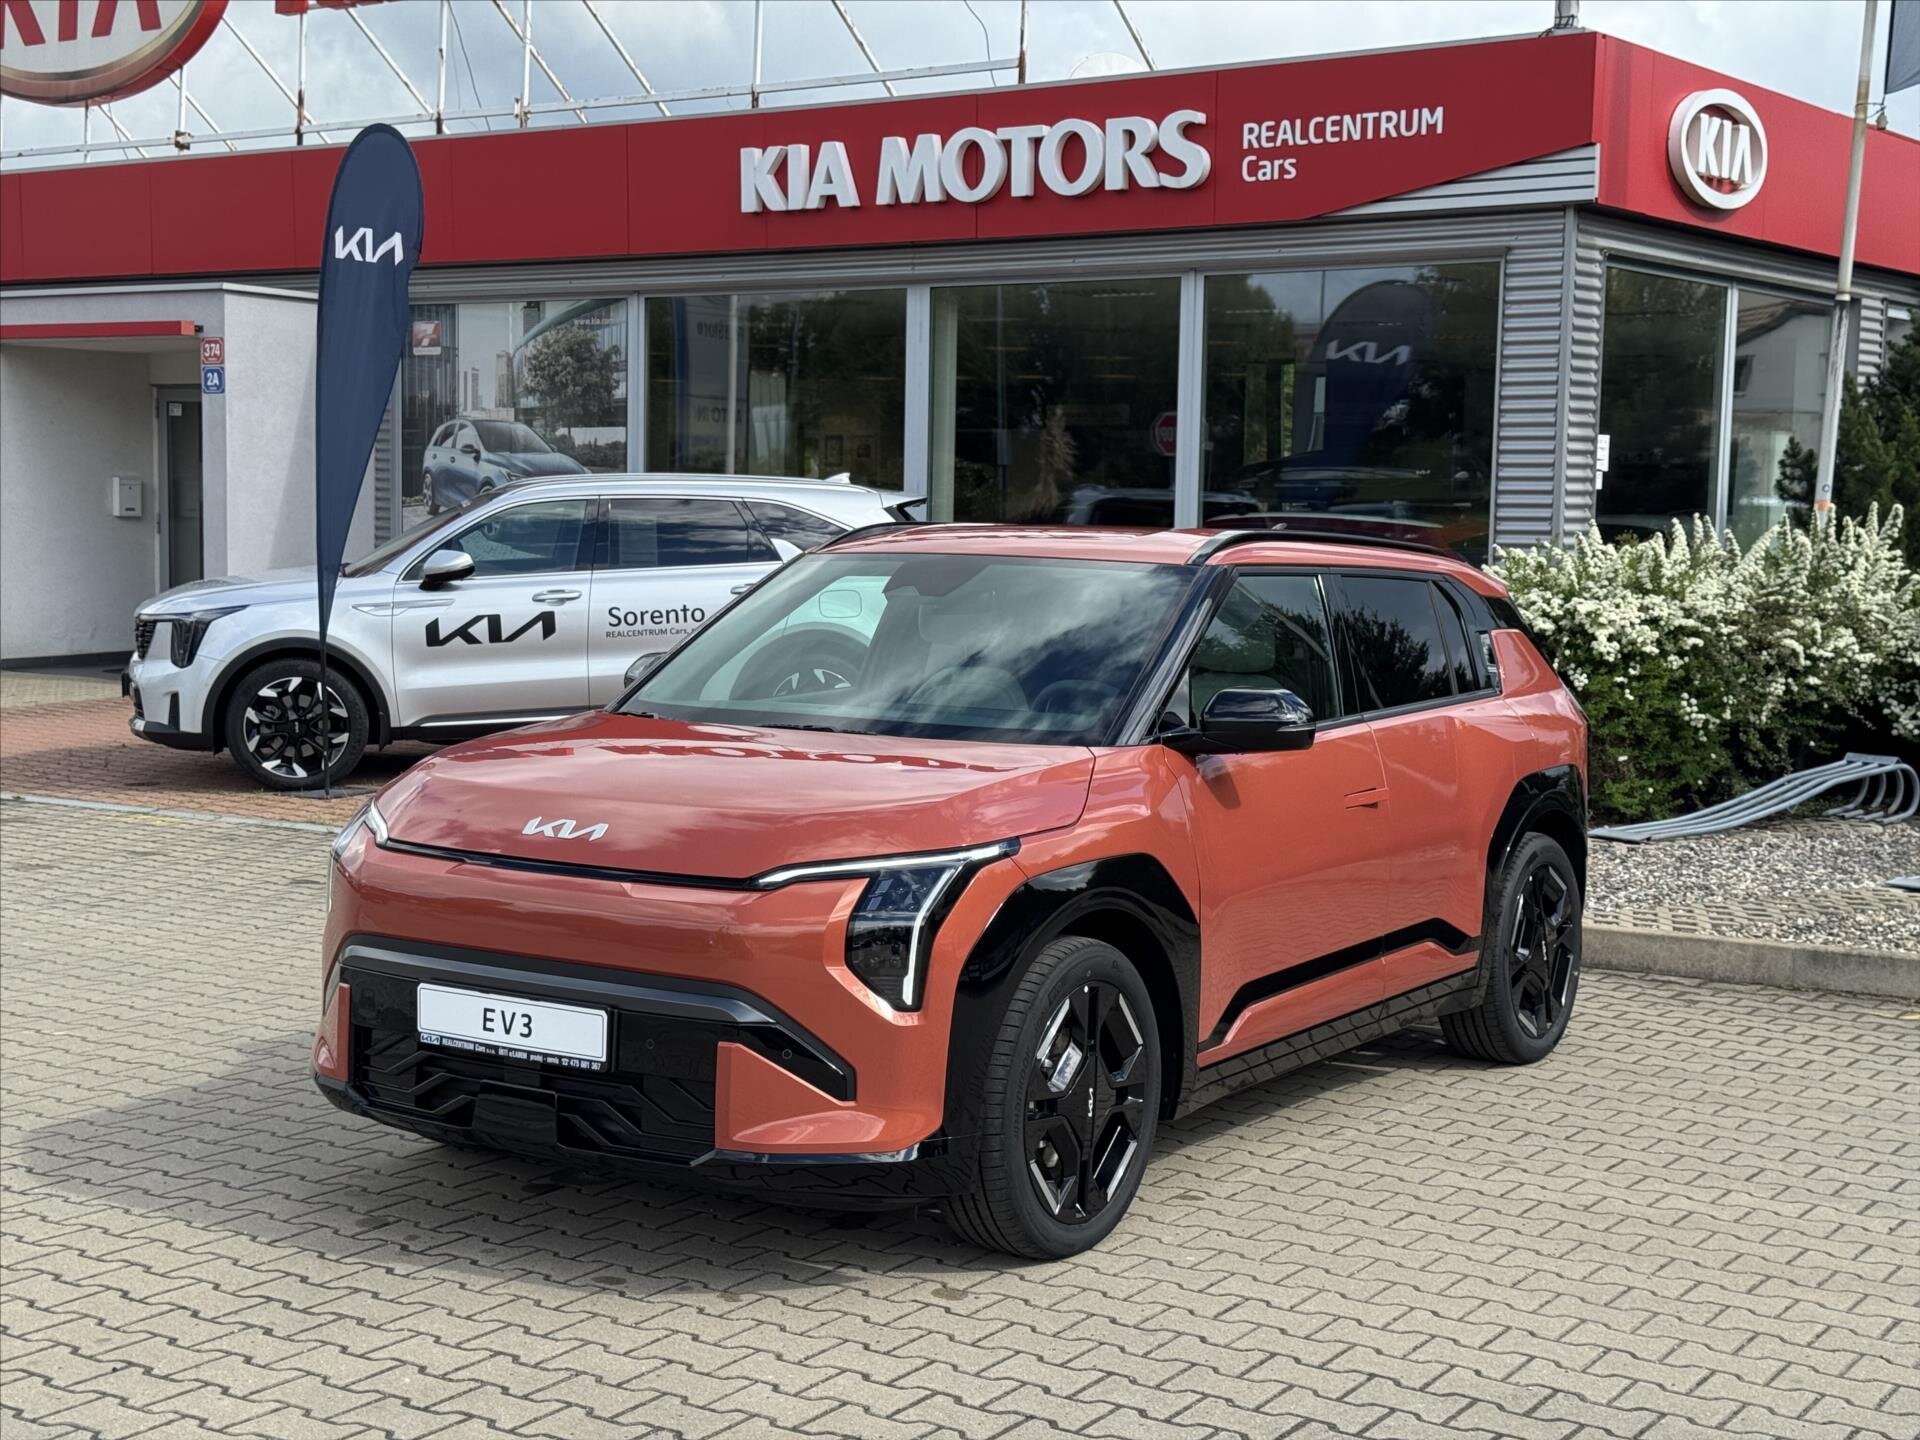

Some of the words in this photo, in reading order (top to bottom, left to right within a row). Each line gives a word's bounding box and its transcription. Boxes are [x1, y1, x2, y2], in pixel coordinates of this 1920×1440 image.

[1242, 106, 1444, 149] REALCENTRUM
[741, 141, 861, 213] KIA
[875, 110, 1211, 203] MOTORS
[1698, 113, 1752, 184] KIA
[1242, 155, 1297, 182] Cars
[335, 225, 404, 267] KIA
[204, 344, 221, 357] 374
[207, 372, 220, 386] 2A
[425, 611, 556, 647] KIA
[608, 604, 705, 627] Sorento
[605, 627, 668, 639] REALCENTRUM
[521, 816, 609, 842] KIA
[482, 1007, 533, 1039] EV3
